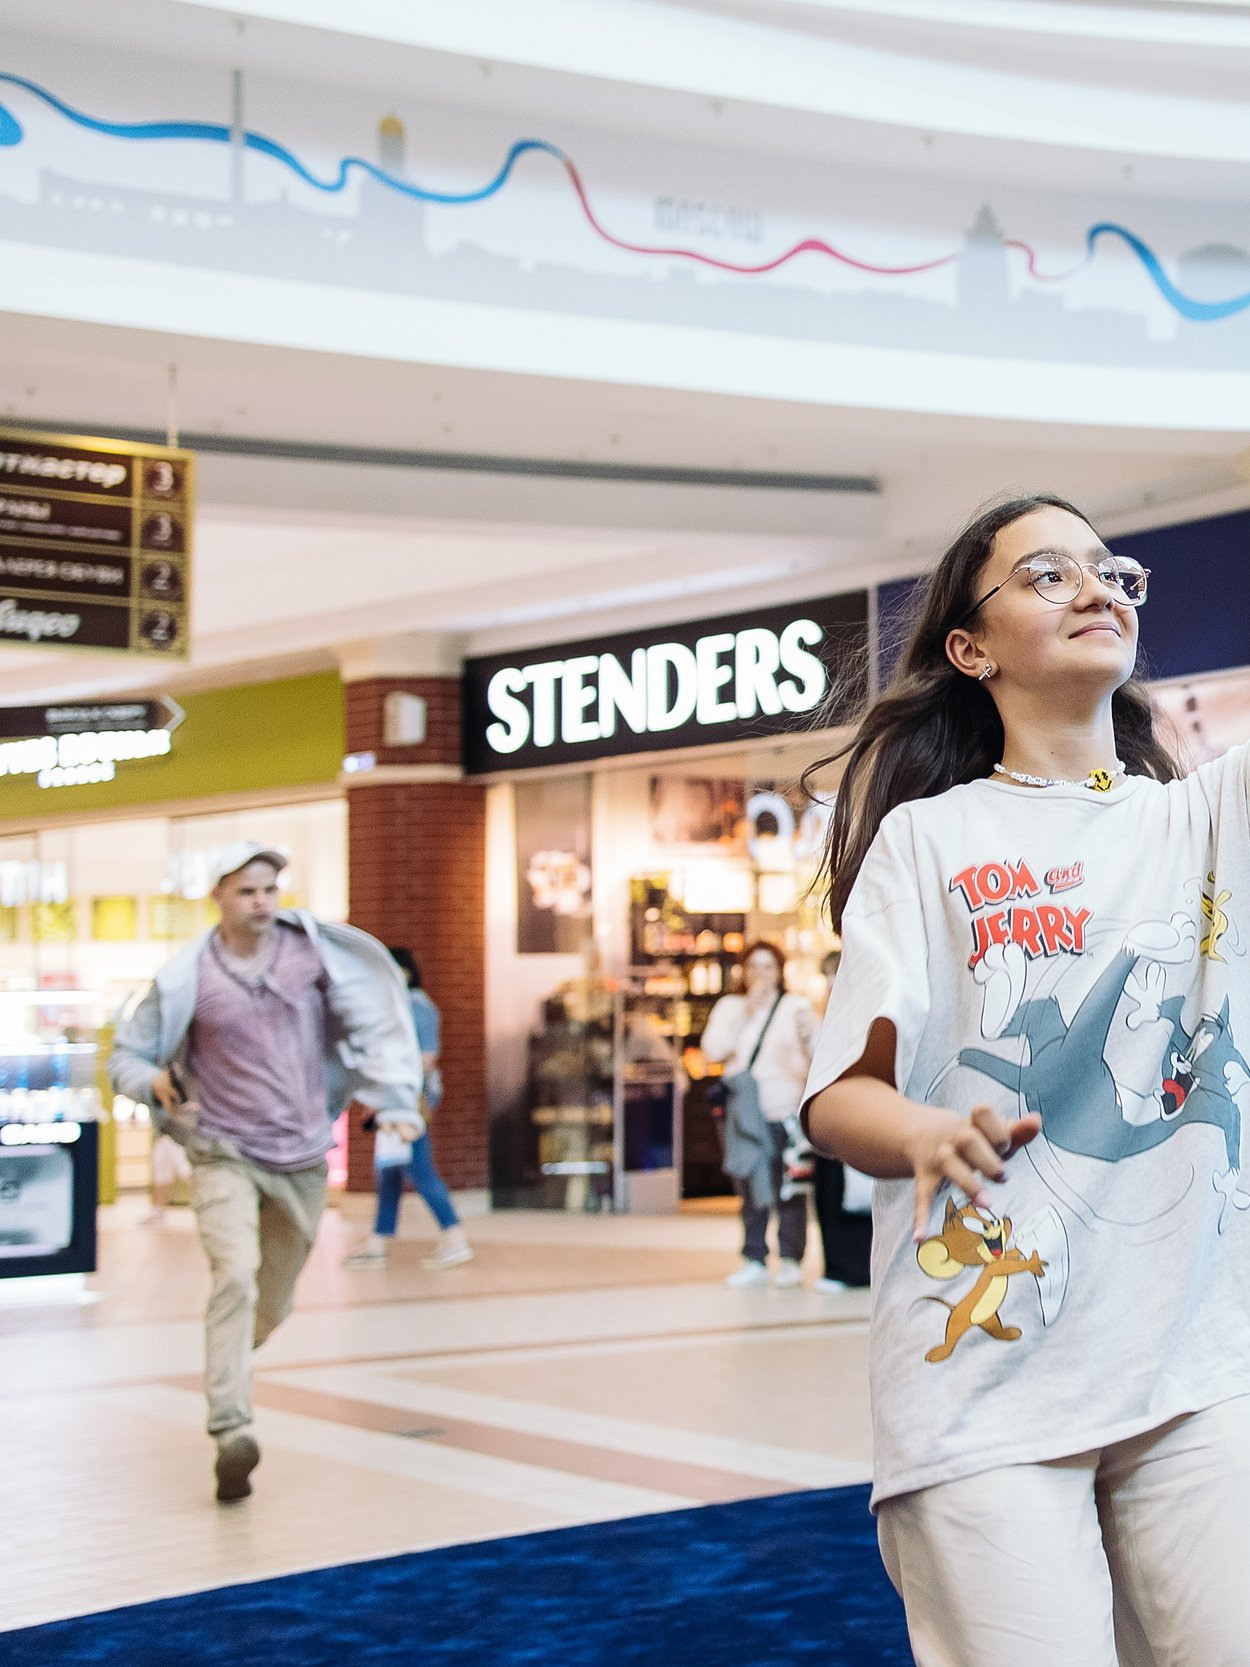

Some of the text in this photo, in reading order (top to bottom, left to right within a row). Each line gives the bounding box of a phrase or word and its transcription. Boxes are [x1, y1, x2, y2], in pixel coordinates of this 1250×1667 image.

[153, 461, 174, 492] 3
[153, 513, 172, 541] 3
[152, 562, 171, 590] 2
[152, 611, 171, 640] 2
[485, 619, 827, 753] STENDERS
[949, 858, 1084, 912] TOM and
[968, 905, 1093, 970] JERRY
